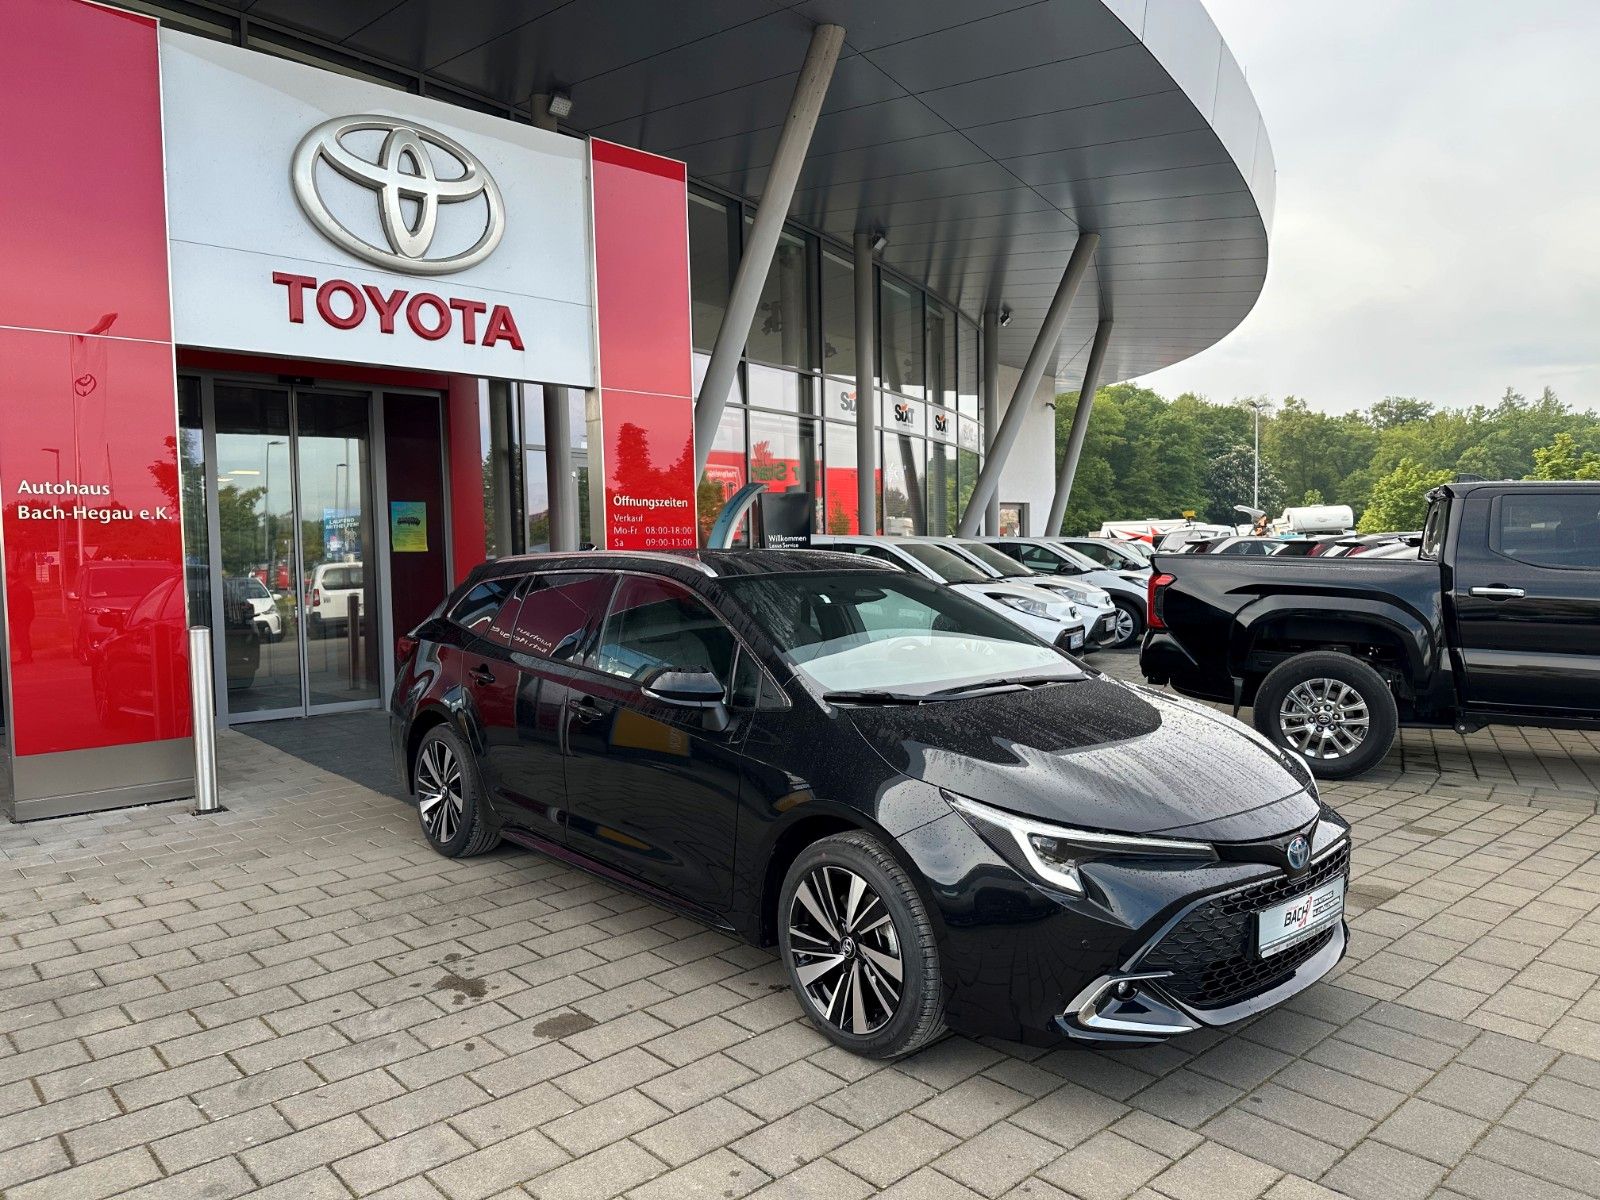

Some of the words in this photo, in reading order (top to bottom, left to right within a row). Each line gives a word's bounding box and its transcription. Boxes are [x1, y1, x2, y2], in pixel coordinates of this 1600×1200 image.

[272, 271, 525, 351] TOYOTA
[17, 479, 110, 495] Autohaus
[613, 493, 688, 510] Öffnungszeiten
[17, 504, 134, 524] Bach-Hegau
[139, 506, 173, 520] e.K.
[613, 513, 643, 523] Verkauf
[613, 526, 638, 535] Mo-Fr
[645, 526, 692, 535] 08:00-18:00
[768, 534, 807, 542] Willkommen
[614, 538, 624, 547] Sa
[645, 538, 692, 547] 09:00-13:00
[1284, 903, 1310, 928] BACH
